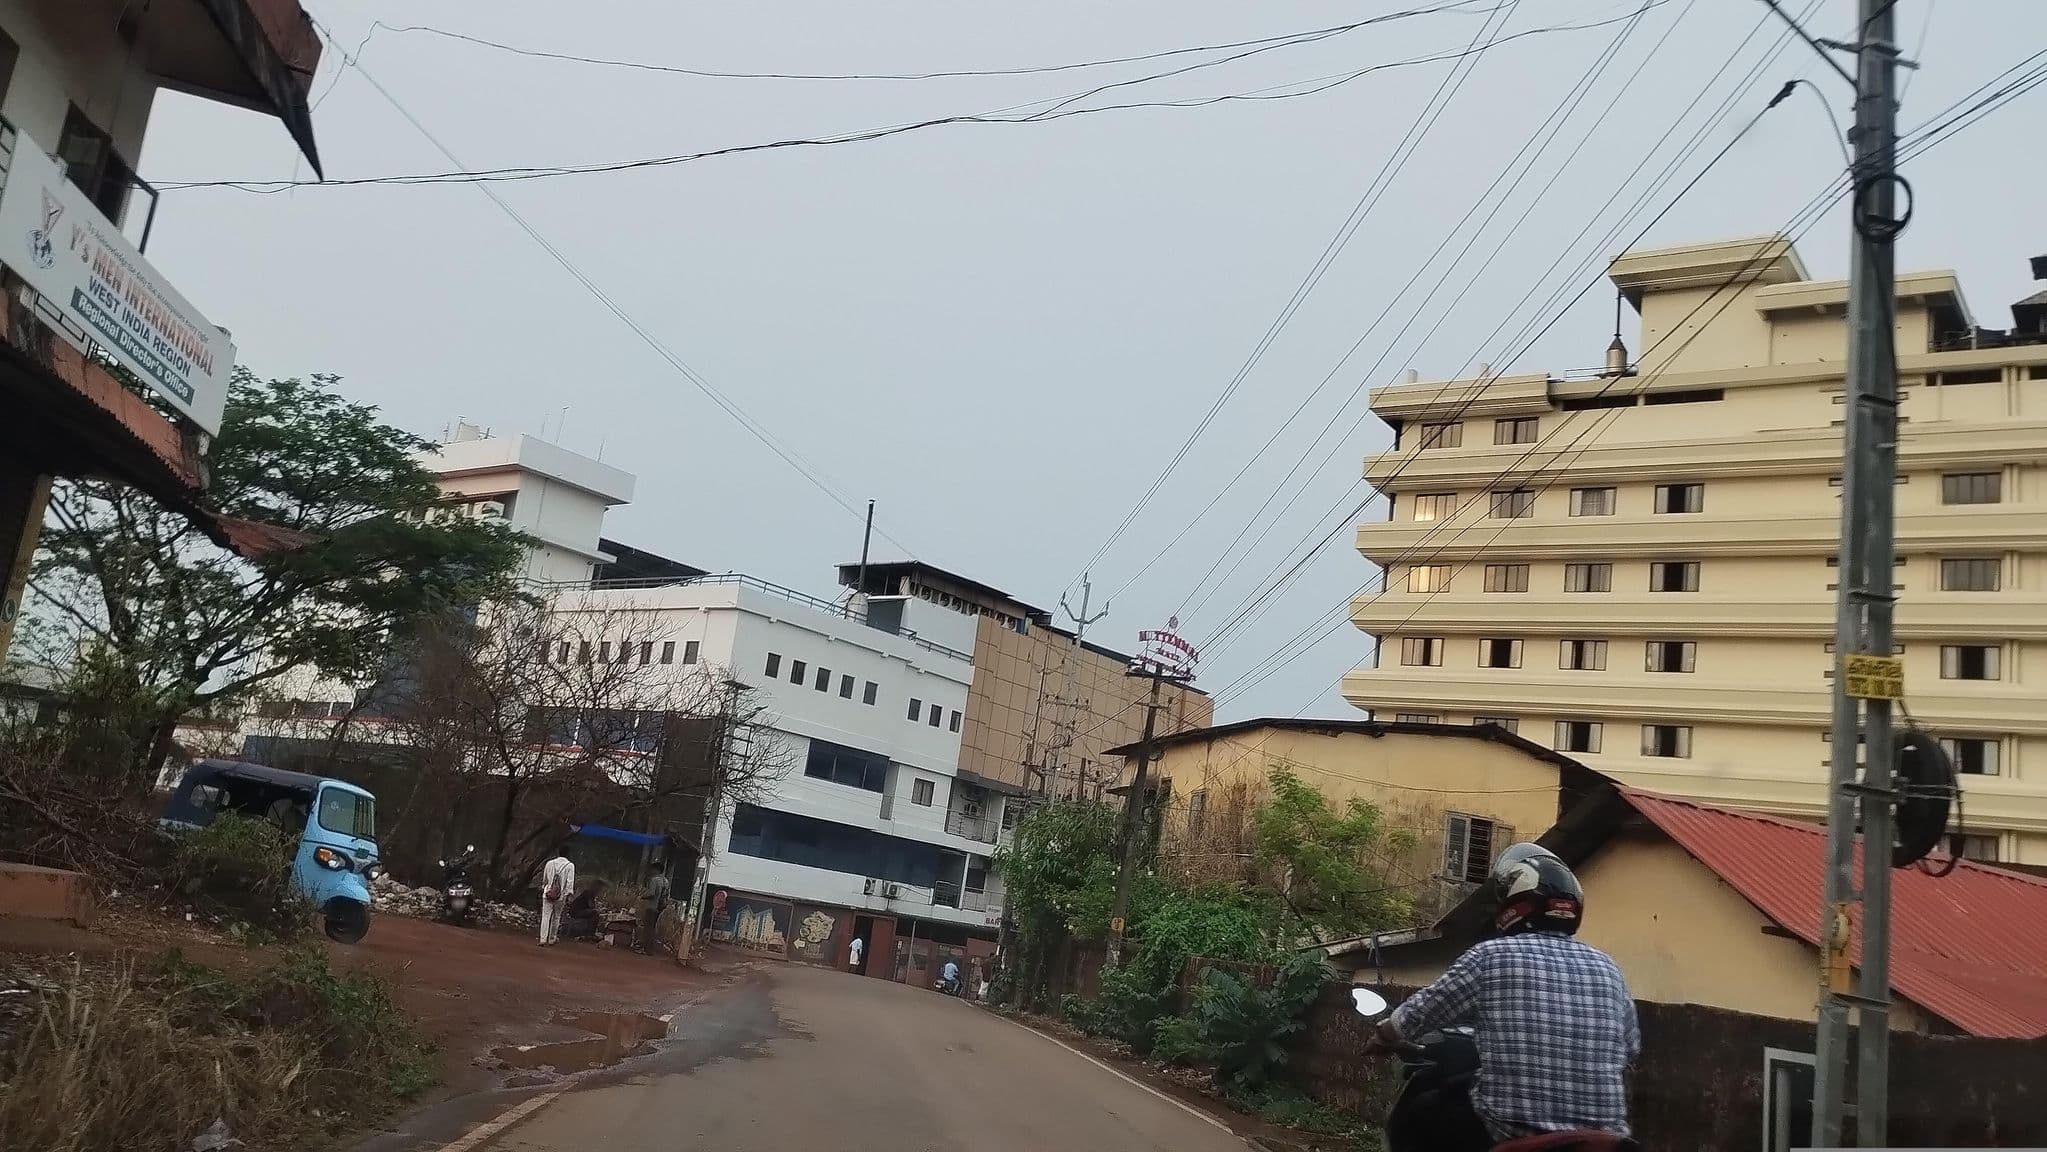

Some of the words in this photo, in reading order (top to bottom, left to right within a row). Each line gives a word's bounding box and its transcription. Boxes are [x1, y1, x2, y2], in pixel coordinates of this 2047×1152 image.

[78, 294, 120, 339] Regional
[119, 331, 163, 377] Director's
[164, 369, 190, 398] Office
[89, 275, 121, 314] WEST
[121, 307, 150, 343] INDIA
[152, 335, 192, 378] REGION
[92, 246, 126, 294] MEN
[124, 276, 214, 378] INTERNATIONAL
